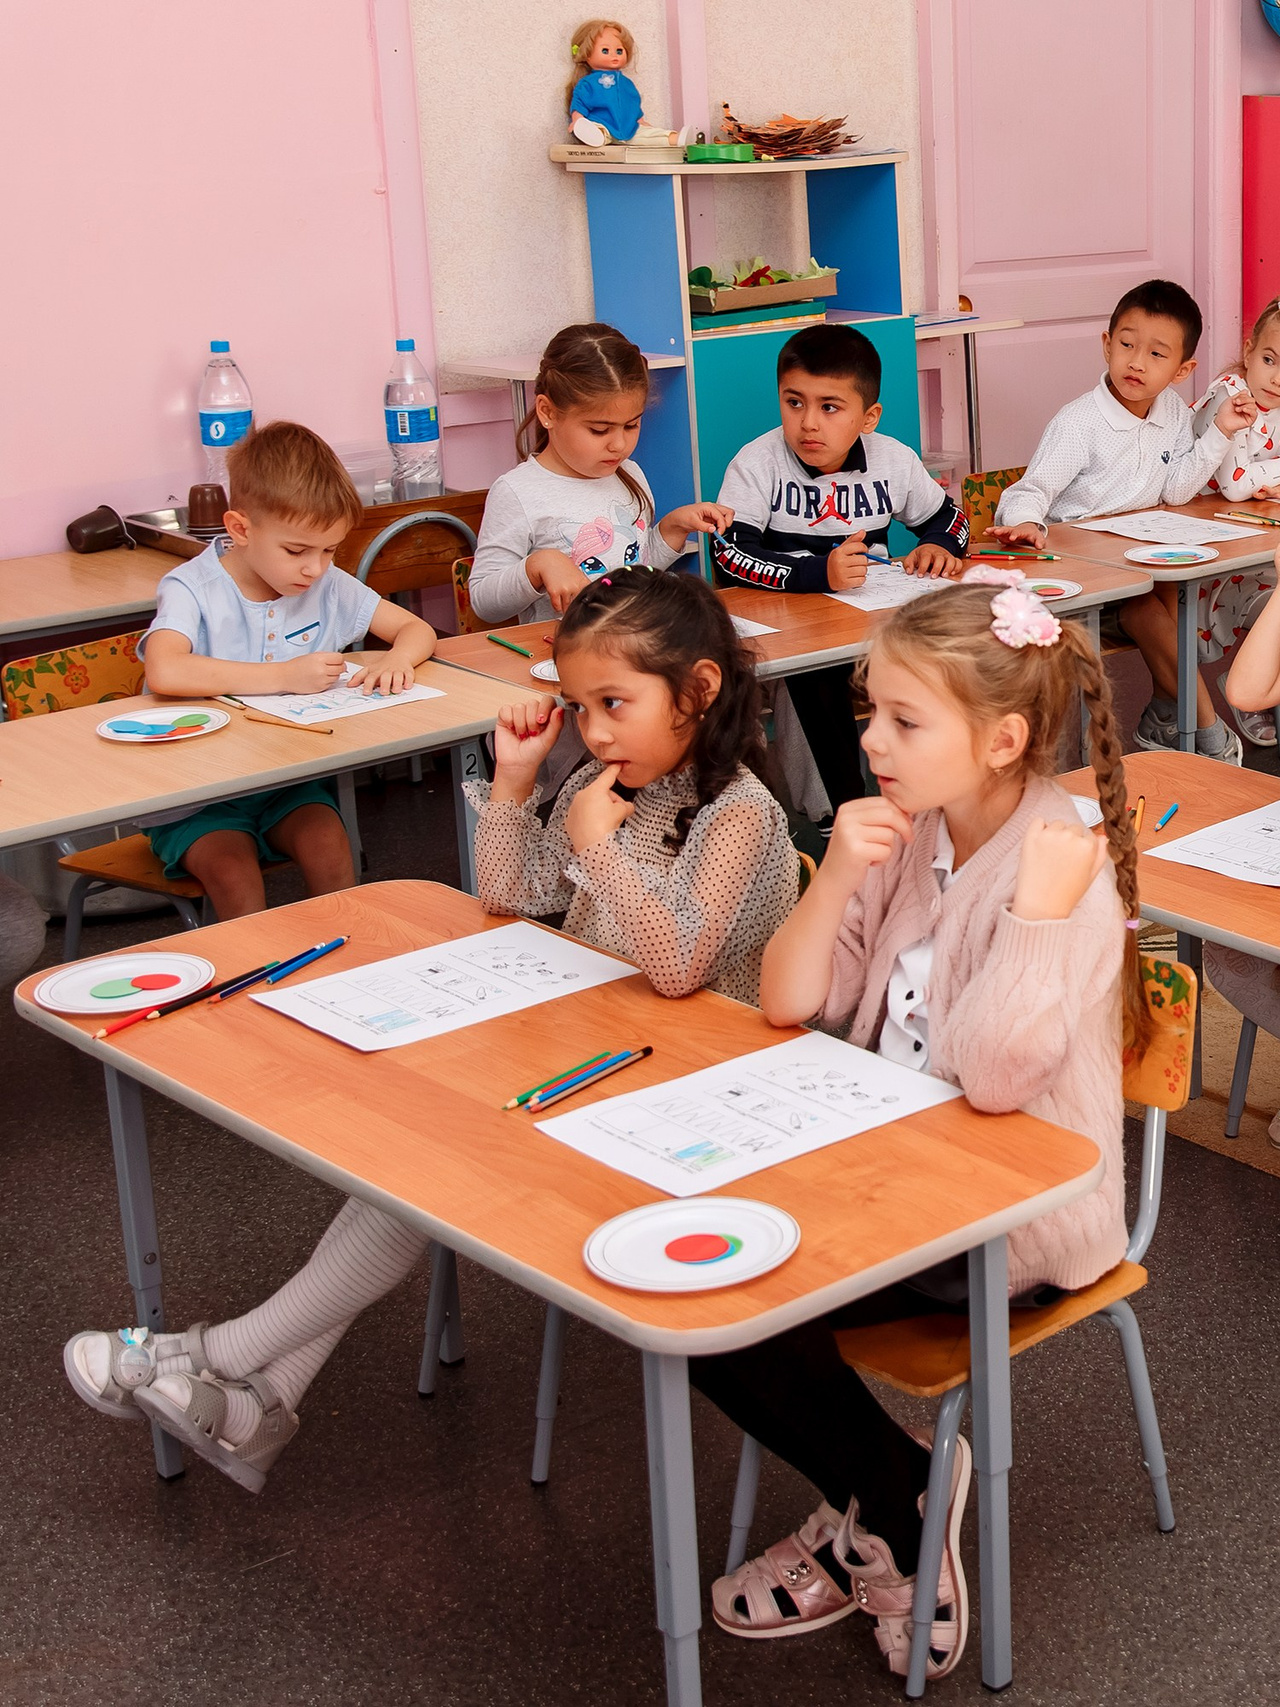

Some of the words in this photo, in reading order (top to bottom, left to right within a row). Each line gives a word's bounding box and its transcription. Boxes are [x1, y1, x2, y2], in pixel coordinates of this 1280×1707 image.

[771, 478, 893, 520] JORDAN
[718, 549, 788, 587] JORDAN
[1178, 588, 1187, 605] 2
[465, 753, 478, 776] 2
